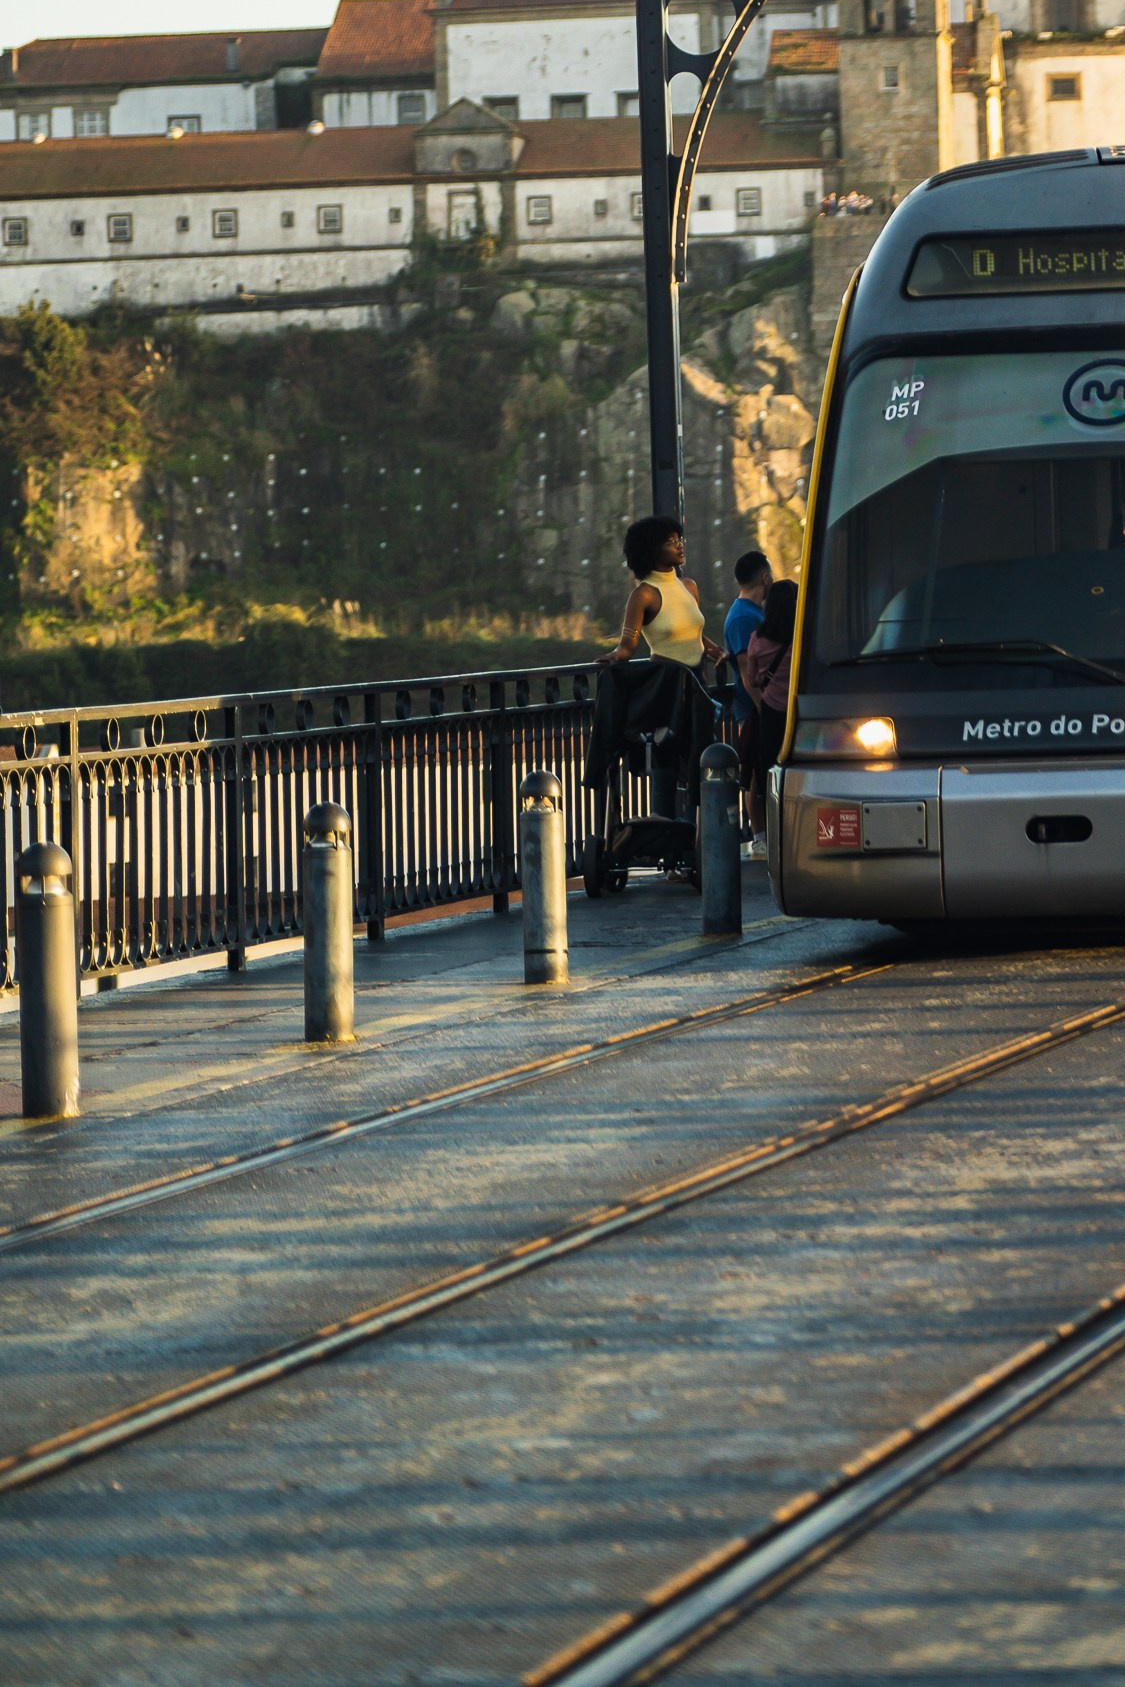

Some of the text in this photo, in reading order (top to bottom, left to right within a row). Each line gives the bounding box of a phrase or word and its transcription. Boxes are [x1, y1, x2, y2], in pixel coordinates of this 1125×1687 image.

[973, 249, 995, 276] D
[891, 380, 925, 401] MP
[884, 399, 920, 421] 051
[962, 719, 1042, 741] Metro
[1050, 714, 1083, 736] do
